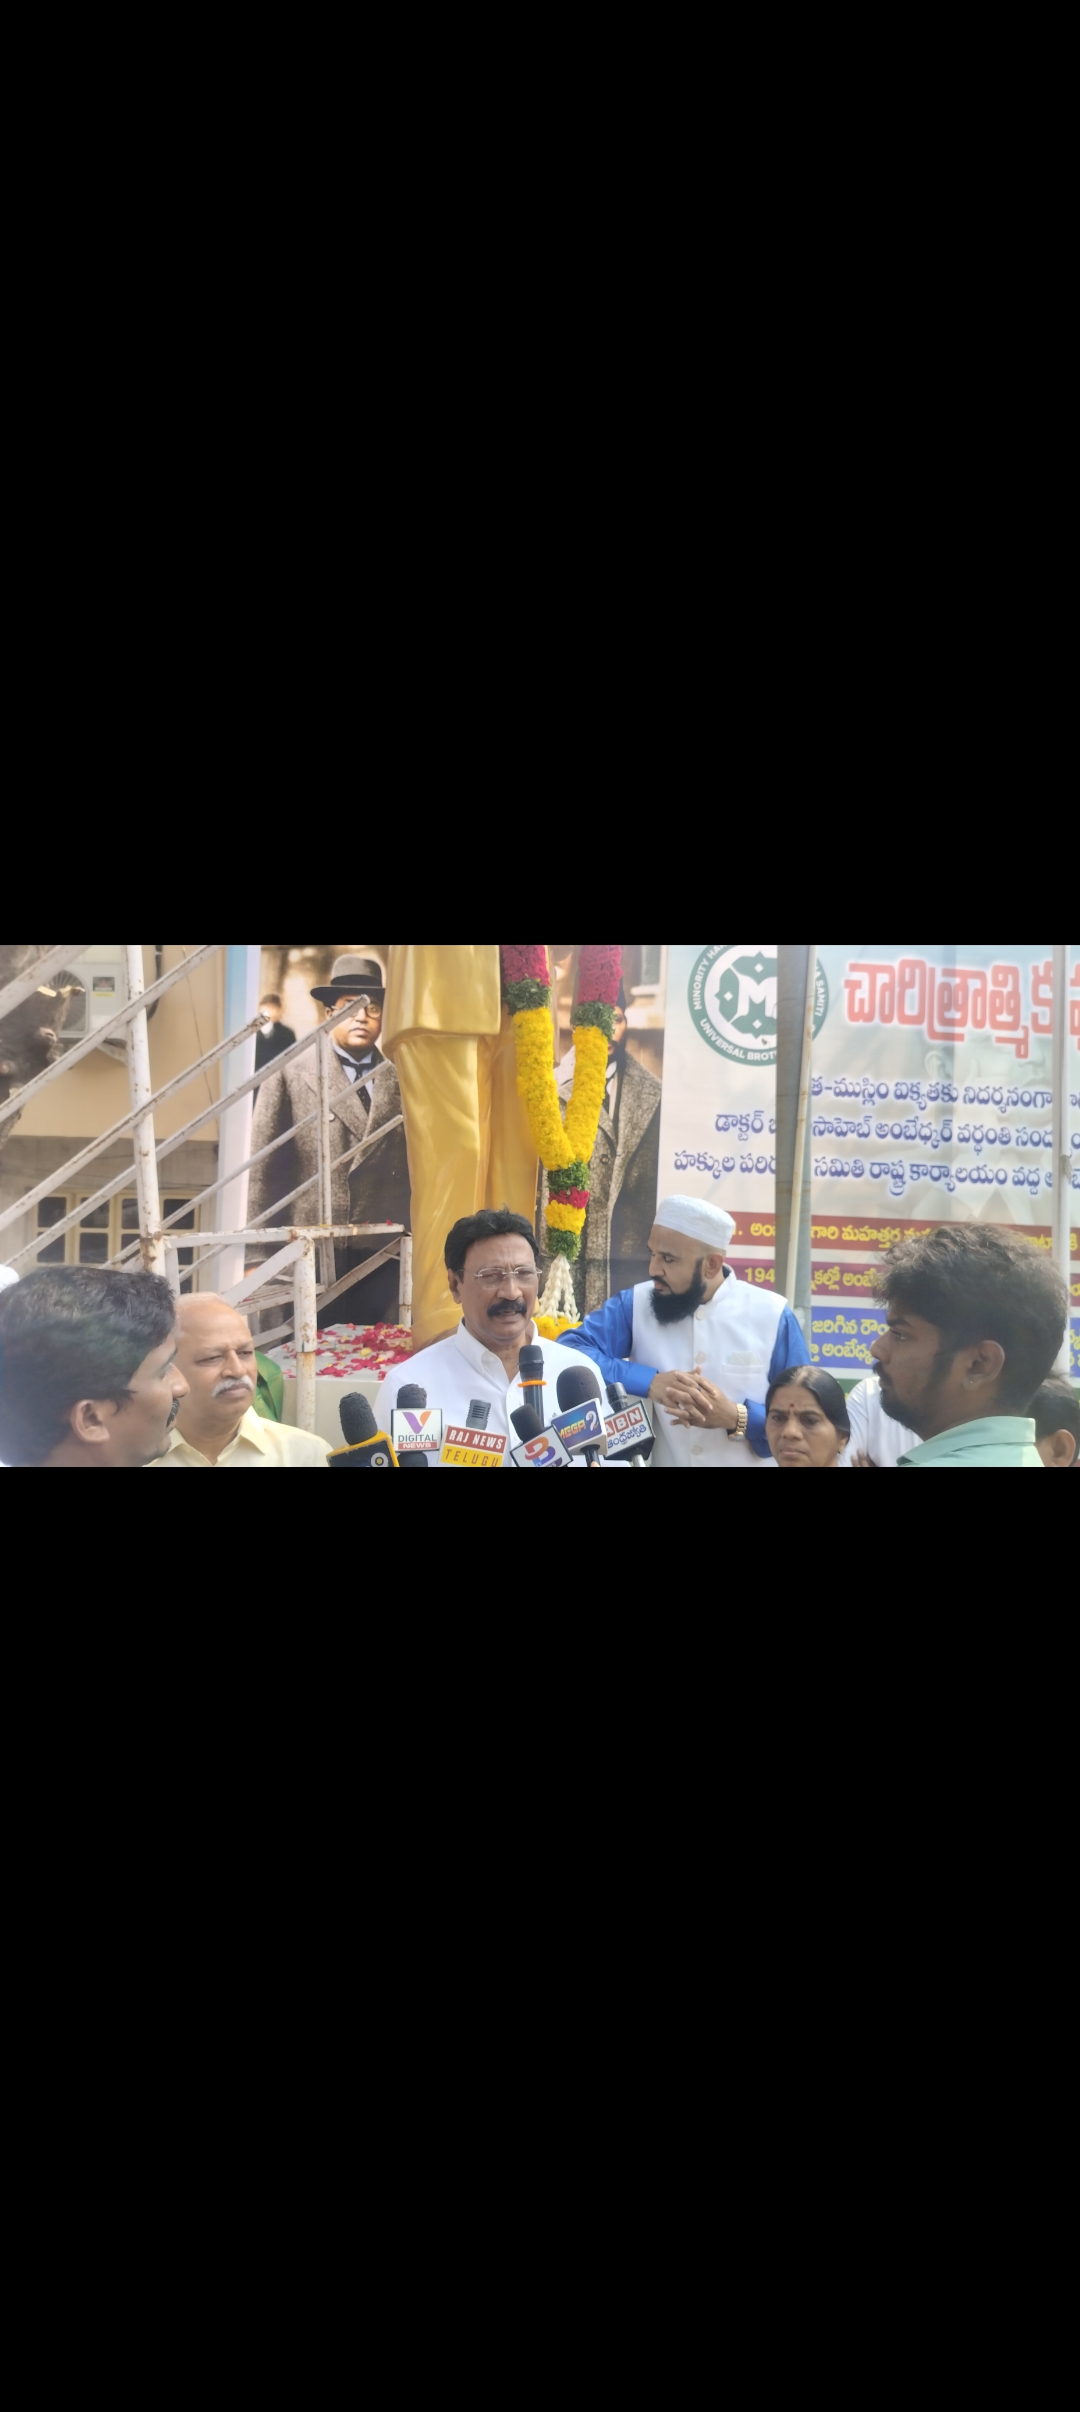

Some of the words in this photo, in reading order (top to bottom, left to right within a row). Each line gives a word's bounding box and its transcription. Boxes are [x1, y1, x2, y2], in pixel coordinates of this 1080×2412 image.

[692, 957, 710, 1011] MINORITY
[815, 980, 825, 1017] SAMITI
[699, 1017, 745, 1059] UNIVERSAL
[893, 1081, 959, 1112] ఐక్యతకు
[714, 1110, 765, 1142] డాక్టర్
[673, 1150, 736, 1180] హక్కుల
[813, 1156, 866, 1179] సమితి
[1011, 1166, 1041, 1196] వద్ద
[744, 1266, 776, 1283] 194
[560, 1419, 587, 1440] MEGA
[605, 1407, 643, 1436] ABN
[398, 1434, 438, 1443] DIGITAL
[448, 1429, 471, 1445] RAJ
[472, 1434, 504, 1450] NEWS
[445, 1448, 500, 1467] TELUGU
